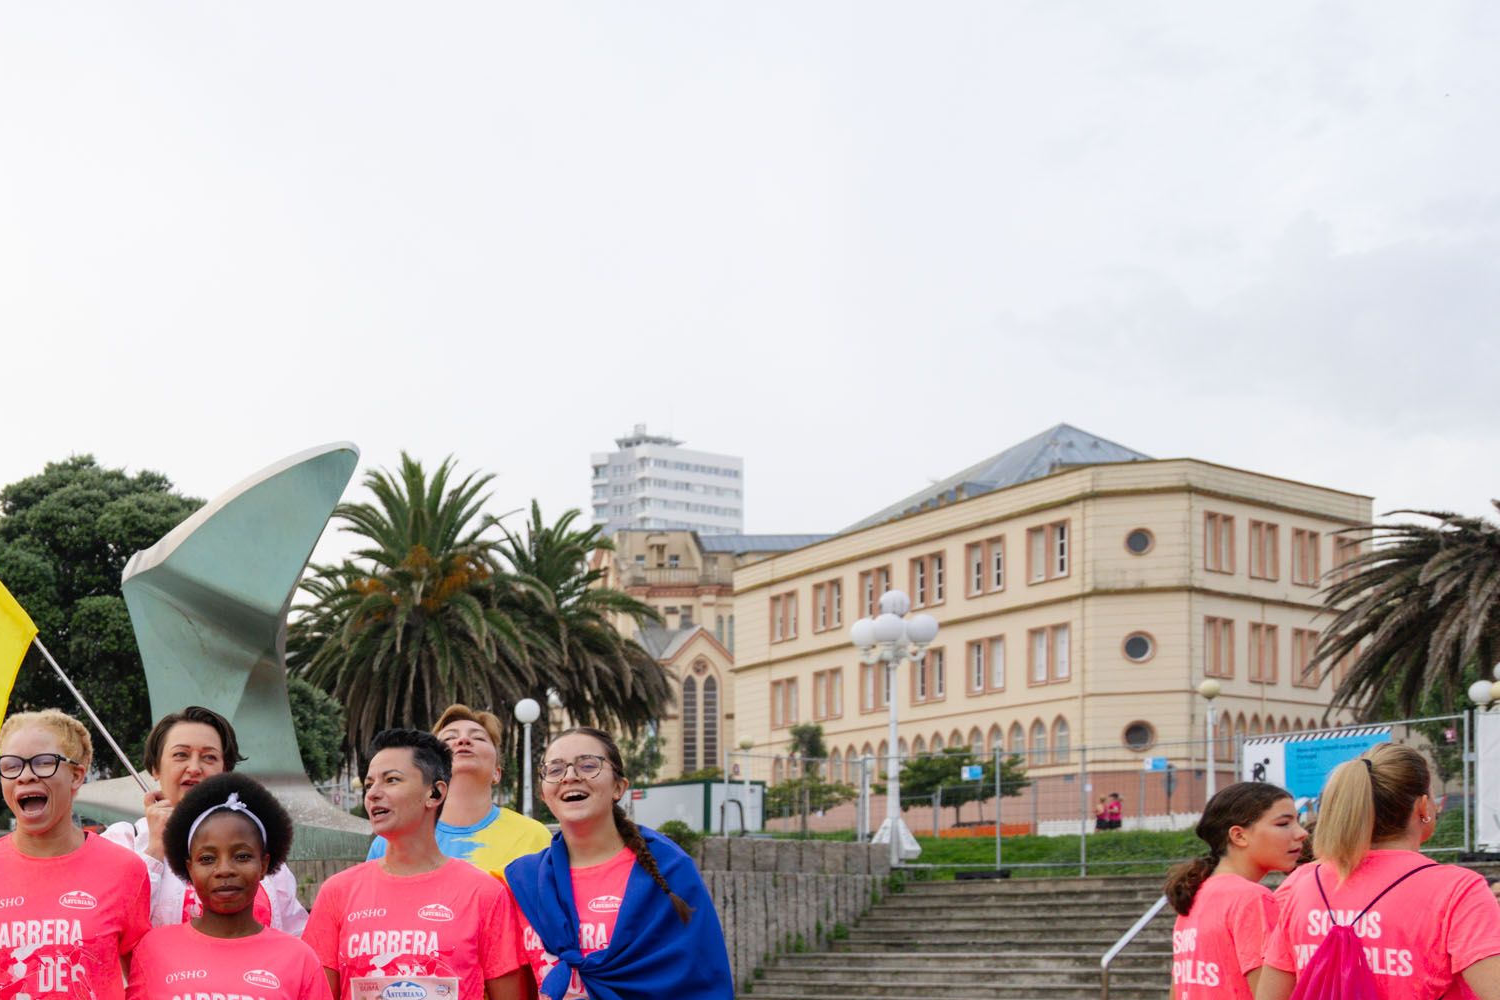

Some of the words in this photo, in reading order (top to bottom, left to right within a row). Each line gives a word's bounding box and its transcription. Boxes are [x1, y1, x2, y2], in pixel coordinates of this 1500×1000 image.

[347, 908, 387, 922] OYSHO
[348, 930, 439, 958] CARRERA
[38, 956, 69, 992] DE
[165, 969, 207, 984] OYSHO
[386, 990, 424, 999] ASTURIANA
